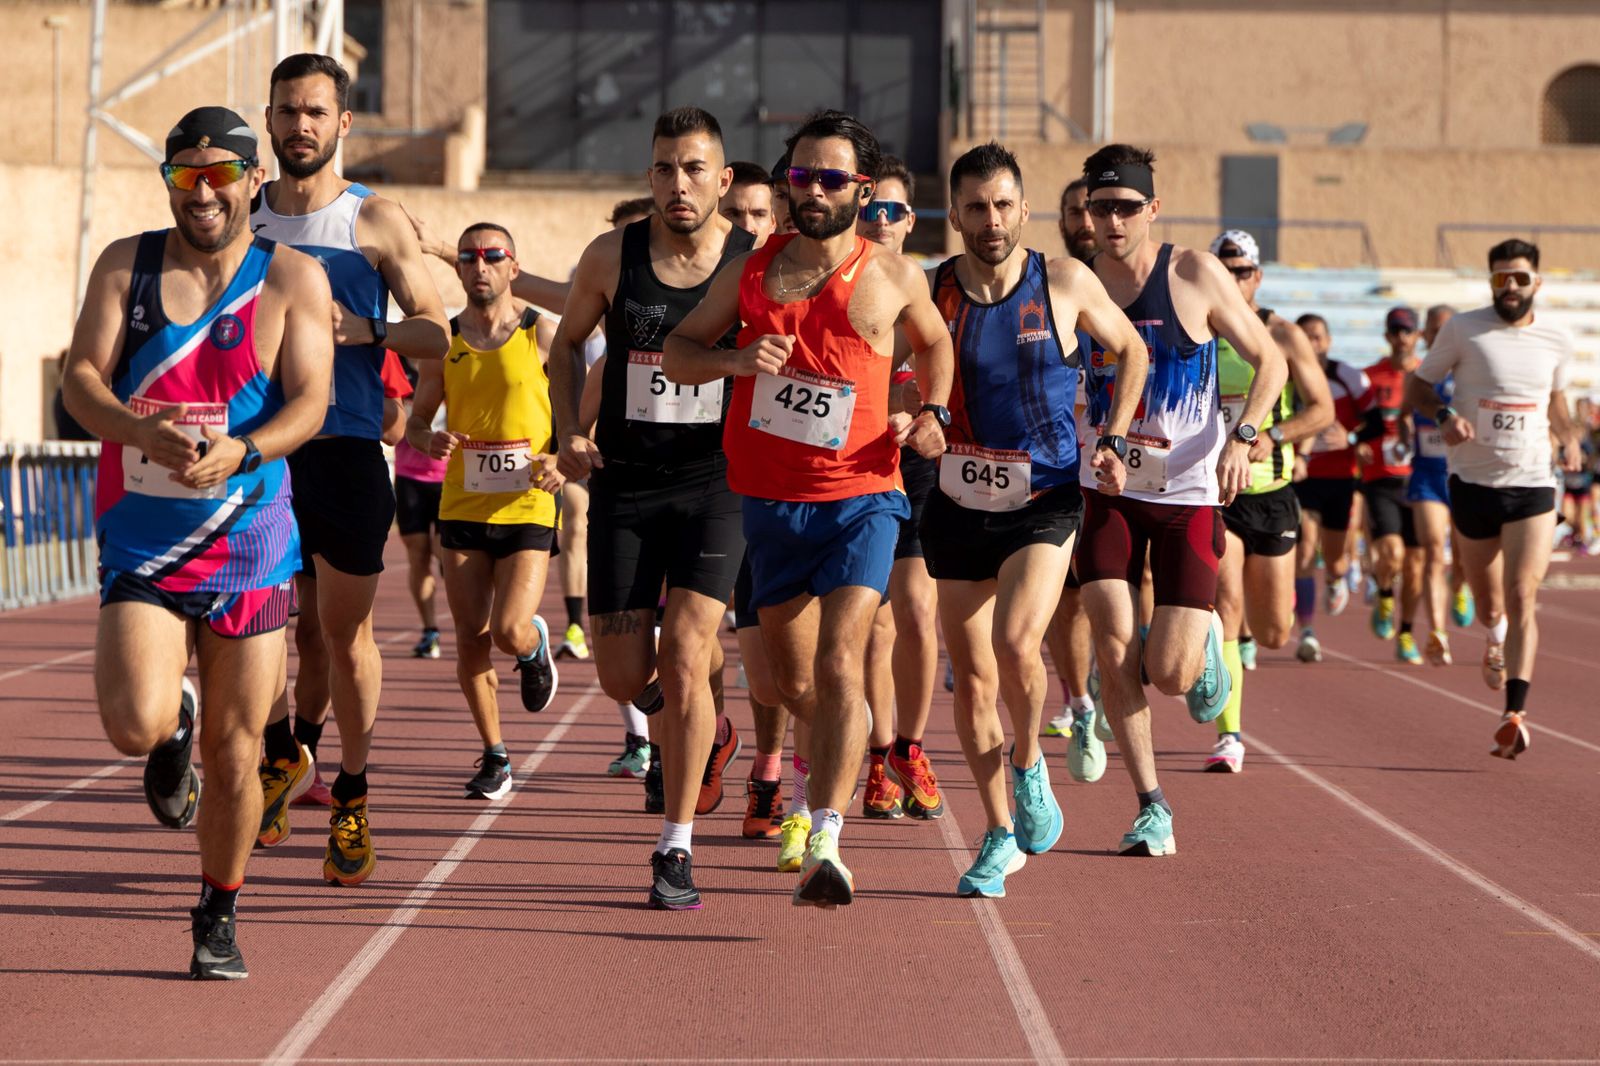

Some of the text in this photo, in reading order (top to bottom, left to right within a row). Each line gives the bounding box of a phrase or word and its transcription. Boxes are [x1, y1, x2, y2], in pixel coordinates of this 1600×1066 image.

[775, 383, 832, 418] 425
[186, 414, 197, 423] DE
[1492, 413, 1526, 431] 621
[476, 453, 516, 473] 705
[961, 460, 1010, 490] 645
